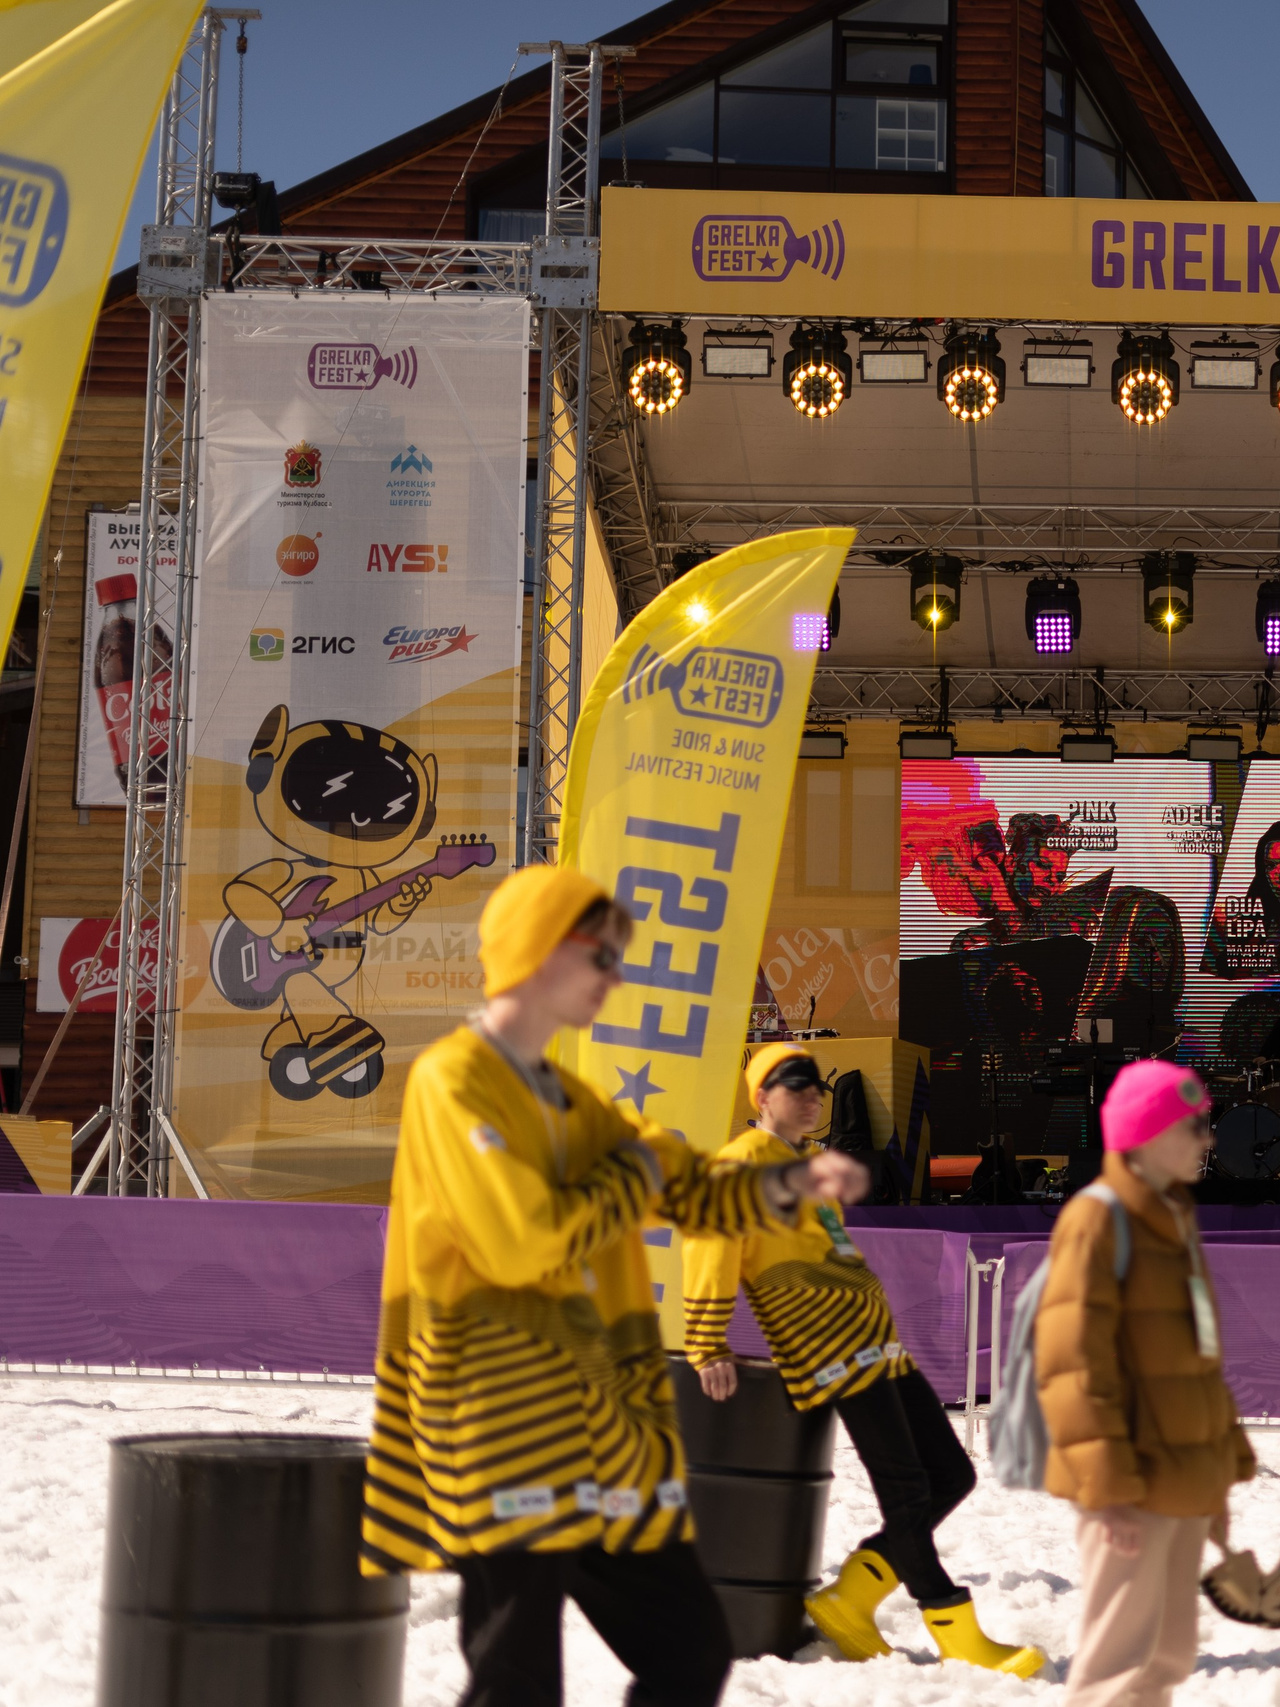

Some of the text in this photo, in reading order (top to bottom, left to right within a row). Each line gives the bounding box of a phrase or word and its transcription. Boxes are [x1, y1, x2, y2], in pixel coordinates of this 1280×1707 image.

[707, 224, 780, 247] GRELKA
[707, 250, 756, 272] FEST
[318, 350, 371, 365] GRELKA
[318, 367, 354, 382] FEST
[386, 480, 436, 489] ДИРЕКЦИЯ
[280, 491, 326, 499] Министерство
[390, 490, 431, 498] КУРОРТА
[389, 499, 432, 507] ШЕРЕГЕШ
[109, 538, 176, 551] ЛУЧЕЕ
[280, 550, 316, 563] энгиро
[366, 543, 449, 573] AYS!
[382, 625, 461, 646] Europa
[291, 635, 356, 655] 2ГИС
[1162, 806, 1223, 825] ADELE
[1046, 837, 1115, 848] СТОКГОЛЬМ
[1226, 898, 1265, 917] DUA
[1226, 919, 1267, 938] LIPA
[405, 971, 487, 989] БОЧКА
